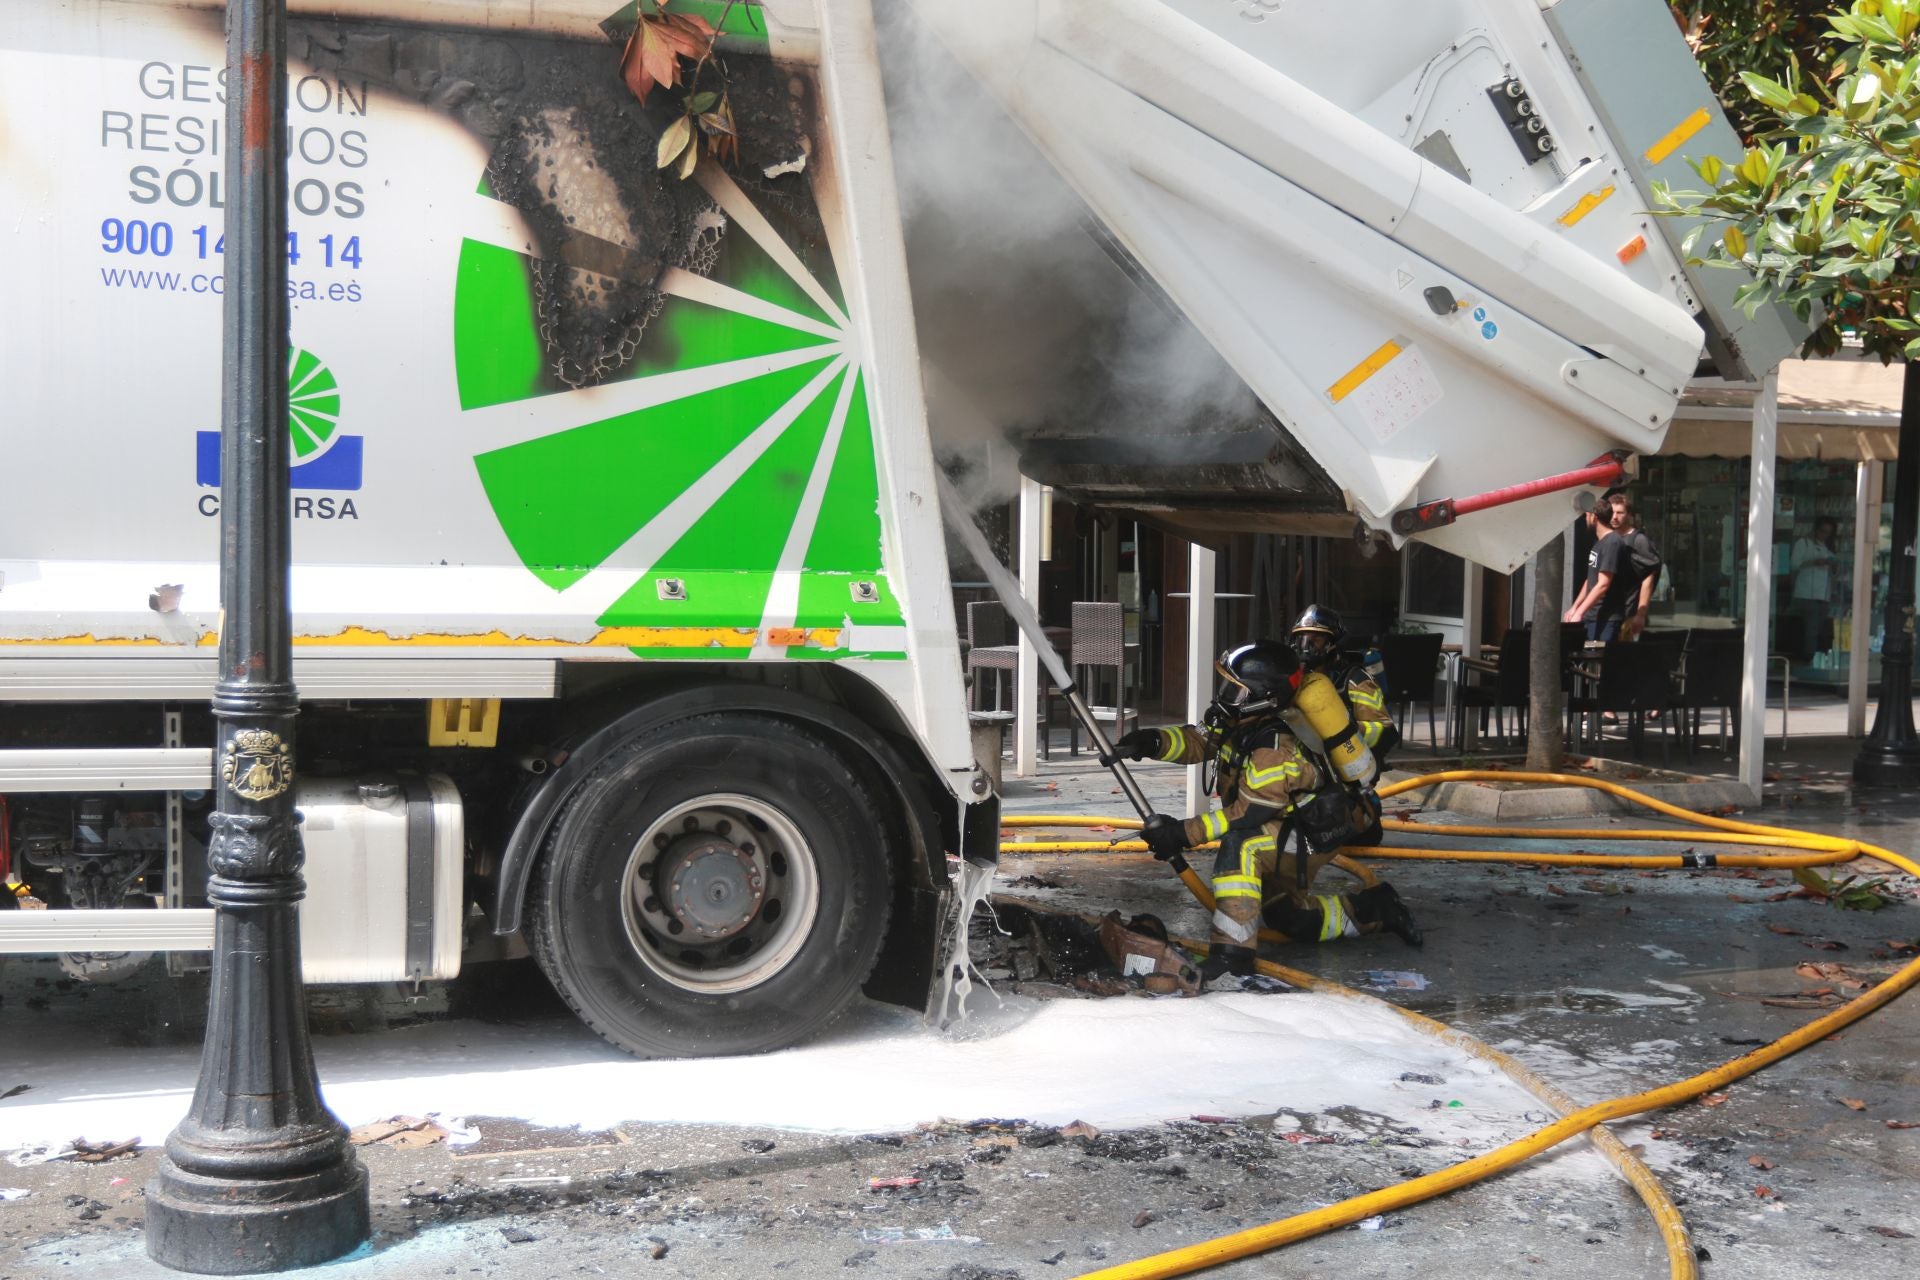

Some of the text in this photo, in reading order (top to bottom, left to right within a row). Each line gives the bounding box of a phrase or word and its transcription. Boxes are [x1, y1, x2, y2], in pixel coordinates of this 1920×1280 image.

[101, 110, 368, 168] RESIOS
[128, 159, 365, 219] SÓLOS
[101, 217, 174, 257] 900
[319, 234, 363, 270] 14
[101, 267, 362, 302] www.cosa.es
[198, 494, 359, 520] CRSA
